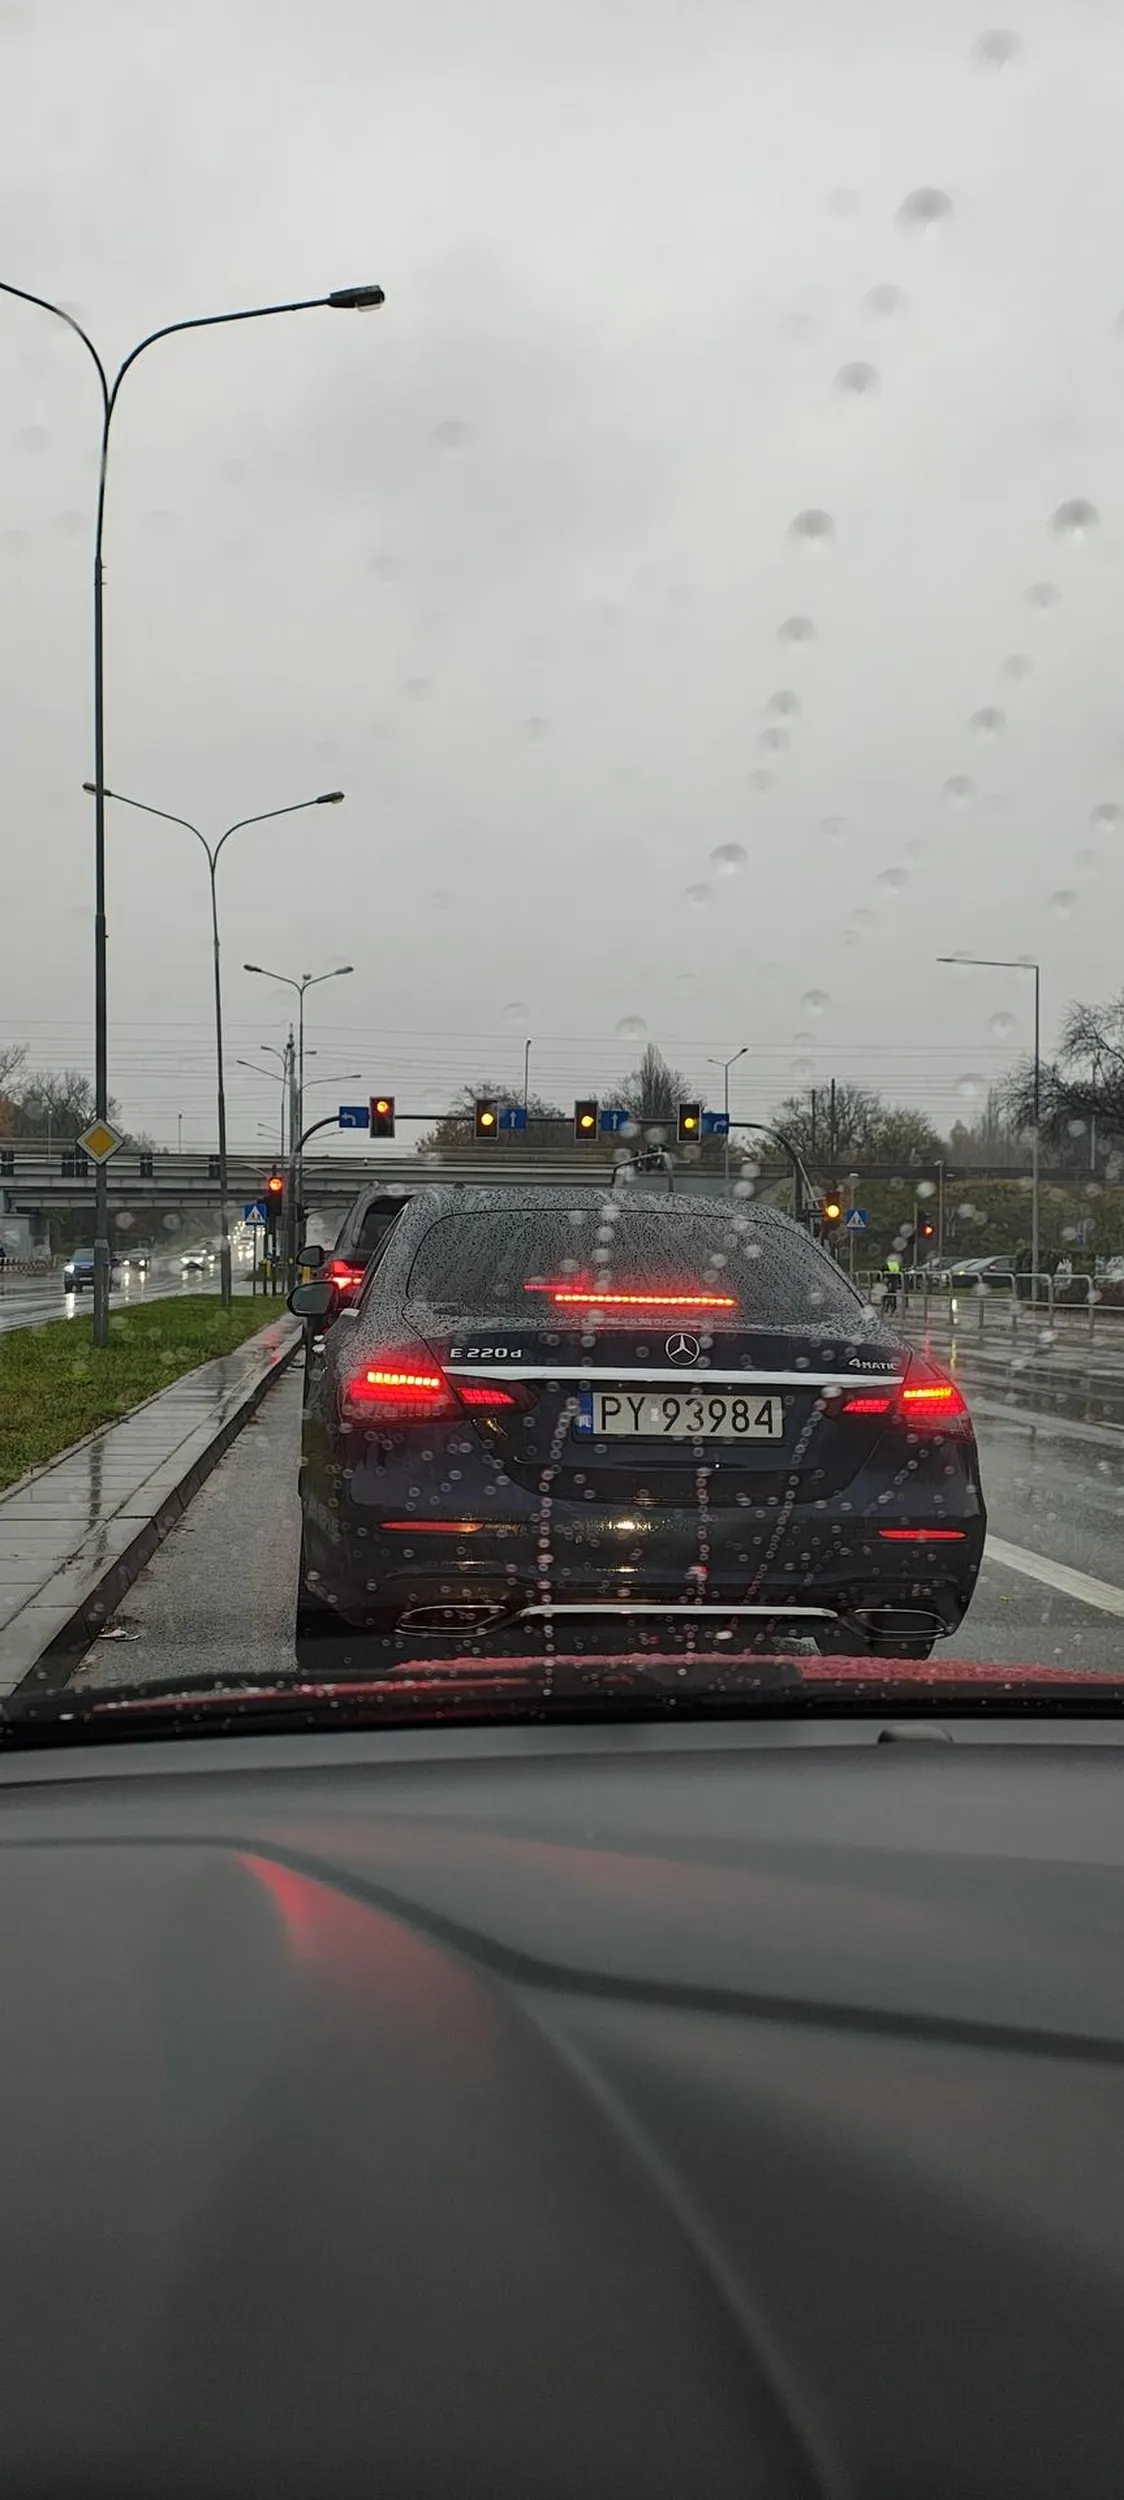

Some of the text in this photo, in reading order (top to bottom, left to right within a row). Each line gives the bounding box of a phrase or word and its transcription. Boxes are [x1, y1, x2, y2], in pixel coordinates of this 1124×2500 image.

[450, 1348, 463, 1358] E
[601, 1396, 773, 1434] PY 93984
